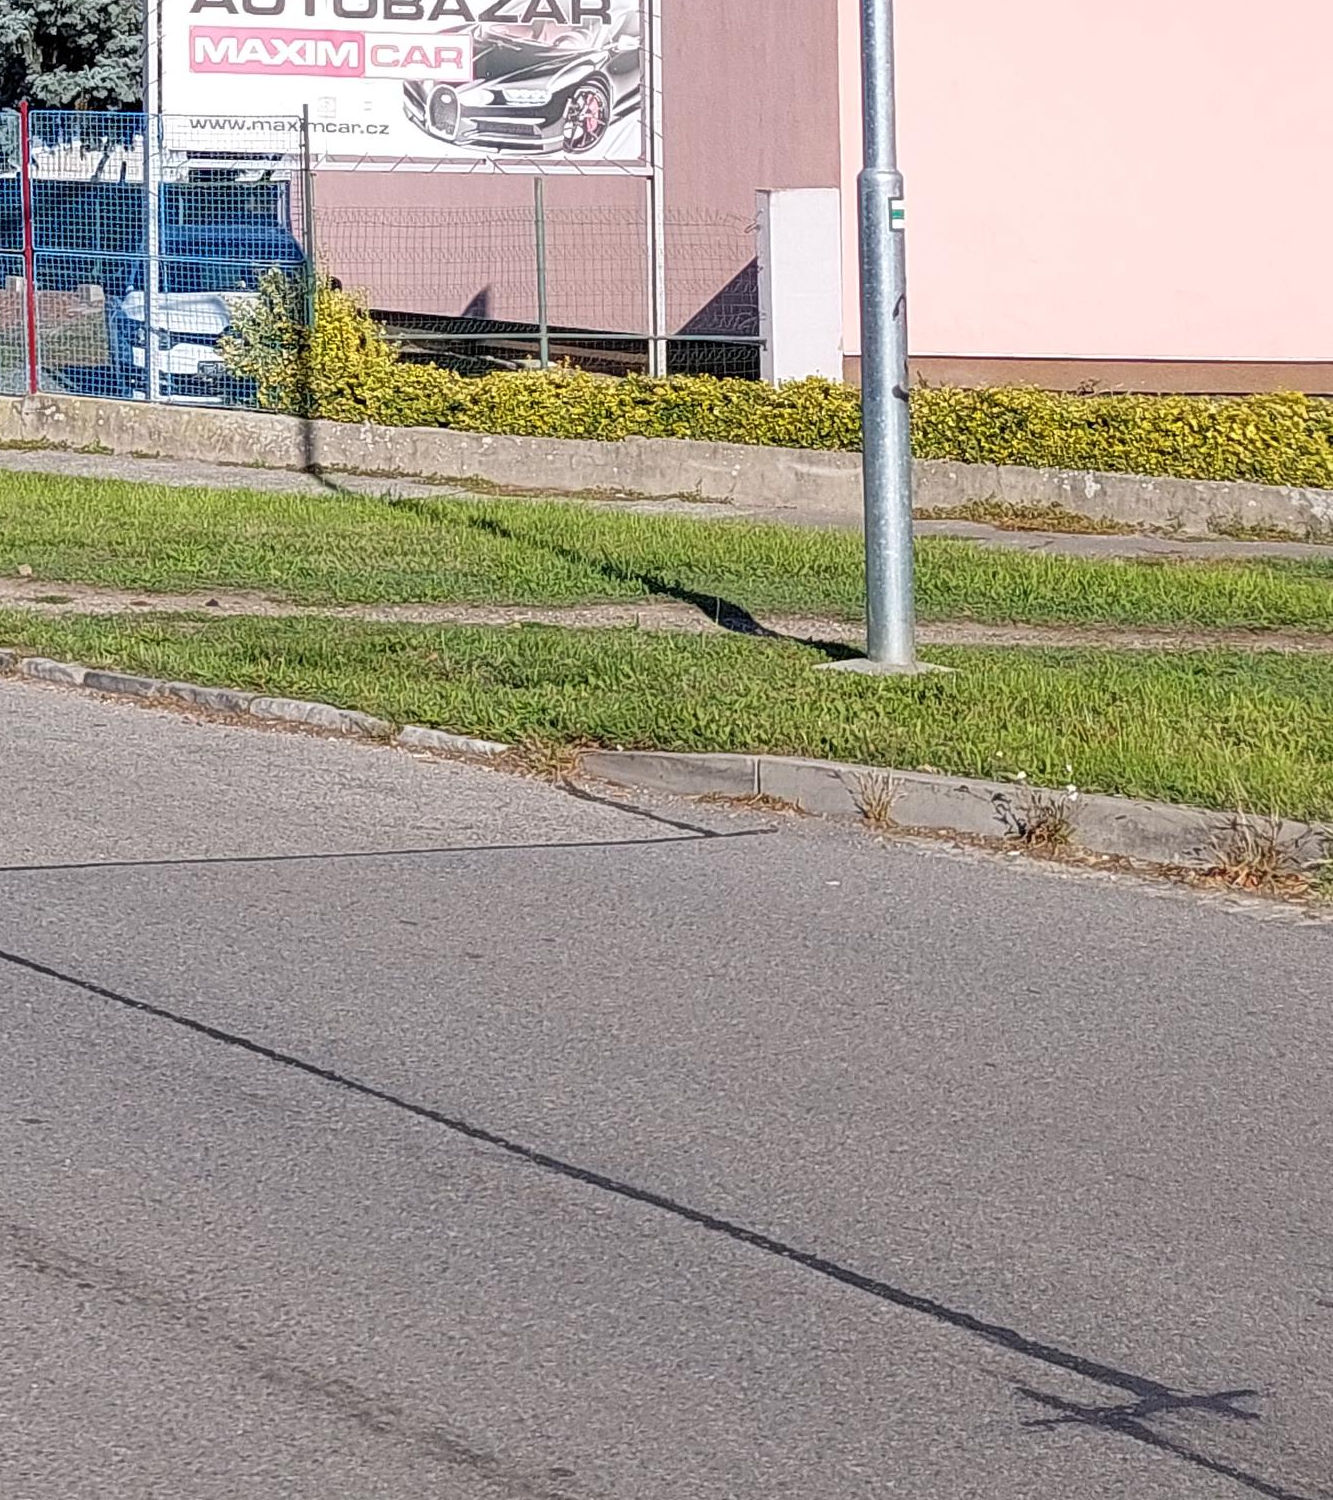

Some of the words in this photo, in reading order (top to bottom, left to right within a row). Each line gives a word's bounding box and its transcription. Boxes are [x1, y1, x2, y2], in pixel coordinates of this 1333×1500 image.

[193, 36, 359, 69] MAXIM
[370, 44, 465, 70] CAR
[189, 118, 390, 136] www.maxmcar.cz
